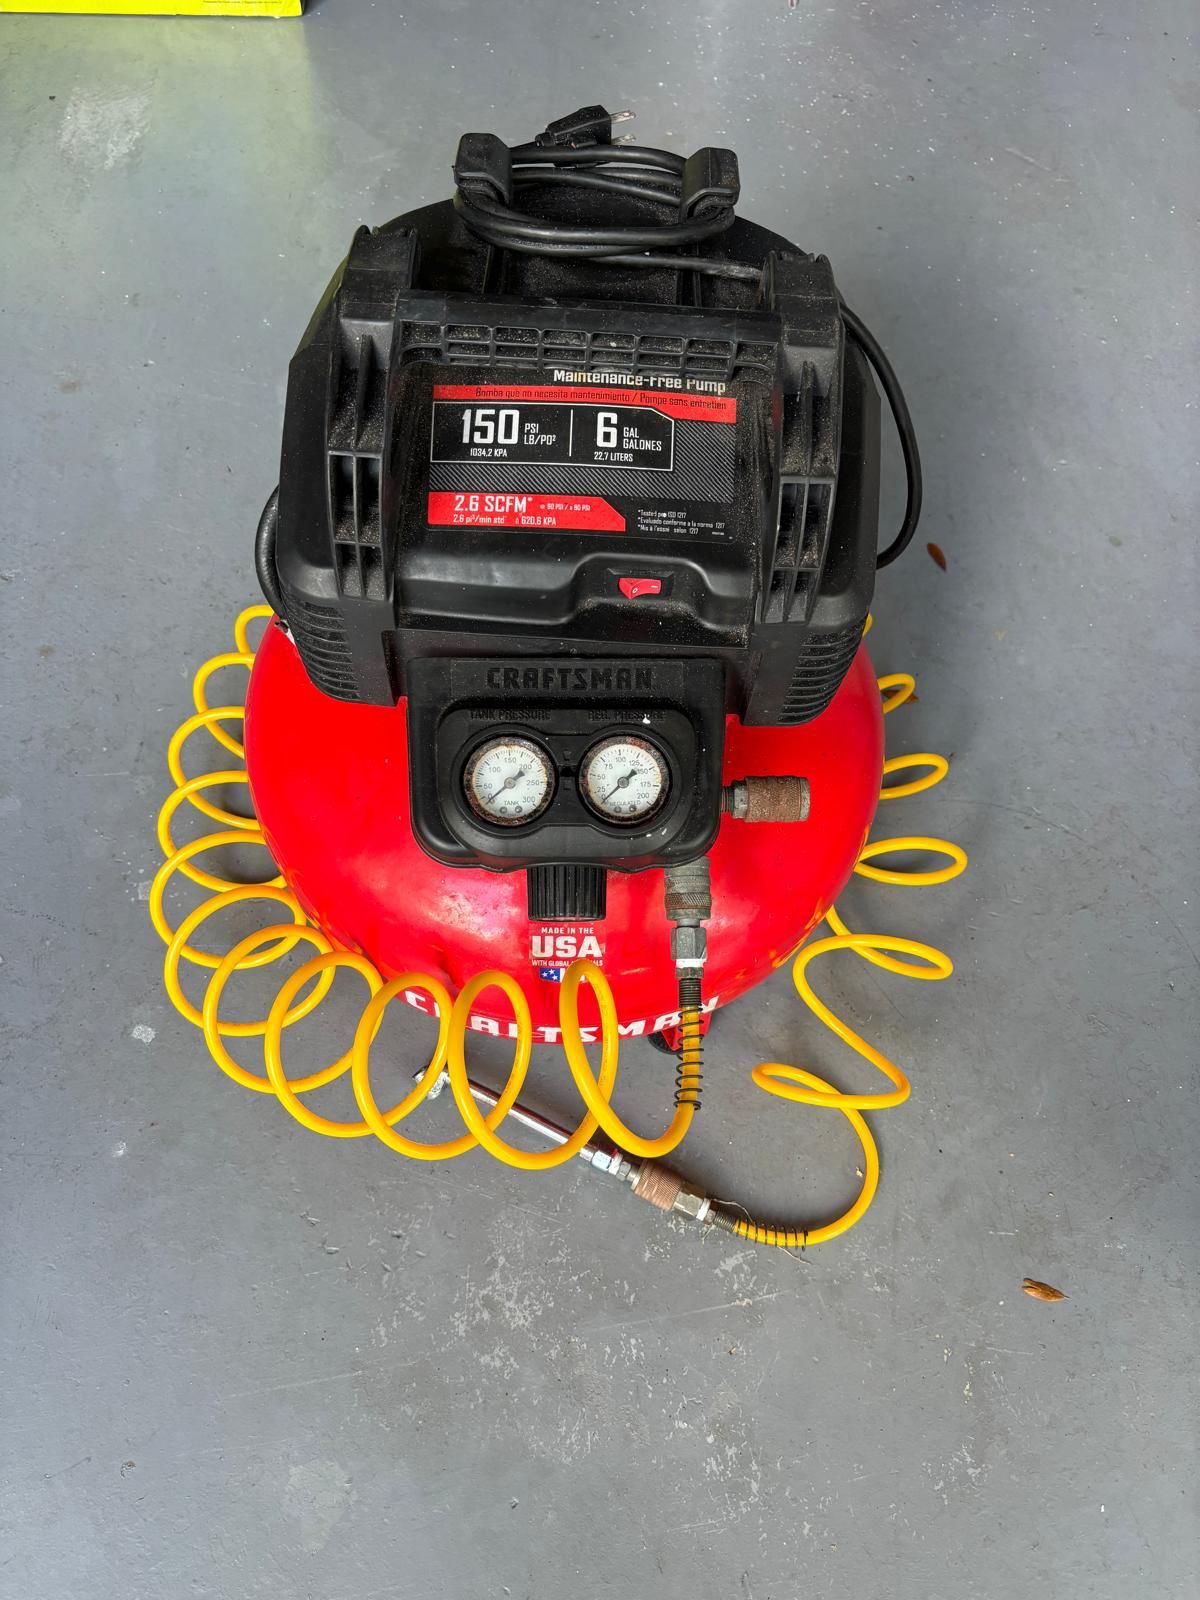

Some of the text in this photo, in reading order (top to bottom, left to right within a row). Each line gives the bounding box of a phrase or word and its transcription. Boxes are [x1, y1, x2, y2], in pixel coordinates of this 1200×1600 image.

[686, 379, 726, 395] Pump
[475, 388, 503, 398] Bomba
[505, 390, 520, 400] que
[522, 391, 533, 399] no
[534, 389, 569, 399] necesita
[570, 390, 630, 402] mantenimiento
[640, 393, 667, 405] Pompe
[669, 397, 688, 407] sans
[690, 399, 727, 410] entretien
[461, 409, 520, 445] 150
[524, 423, 539, 434] PSI
[596, 411, 618, 449] 6
[623, 427, 640, 439] GAL
[623, 439, 662, 452] GALONES
[470, 448, 508, 458] 1034.2 KPA
[594, 451, 634, 463] 22.7 LITERS
[454, 494, 480, 512] 2.6
[453, 513, 464, 523] 2.6
[521, 515, 542, 526] 620.6
[543, 516, 557, 526] KPA
[487, 667, 652, 691] CRAFTSMAN
[471, 709, 551, 721] TANK PRESSURE
[504, 756, 517, 764] 150
[526, 779, 540, 787] 250
[597, 773, 606, 781] 50
[483, 782, 493, 790] 50
[637, 792, 649, 800] 200
[531, 935, 603, 958] USA
[532, 959, 547, 967] WITH
